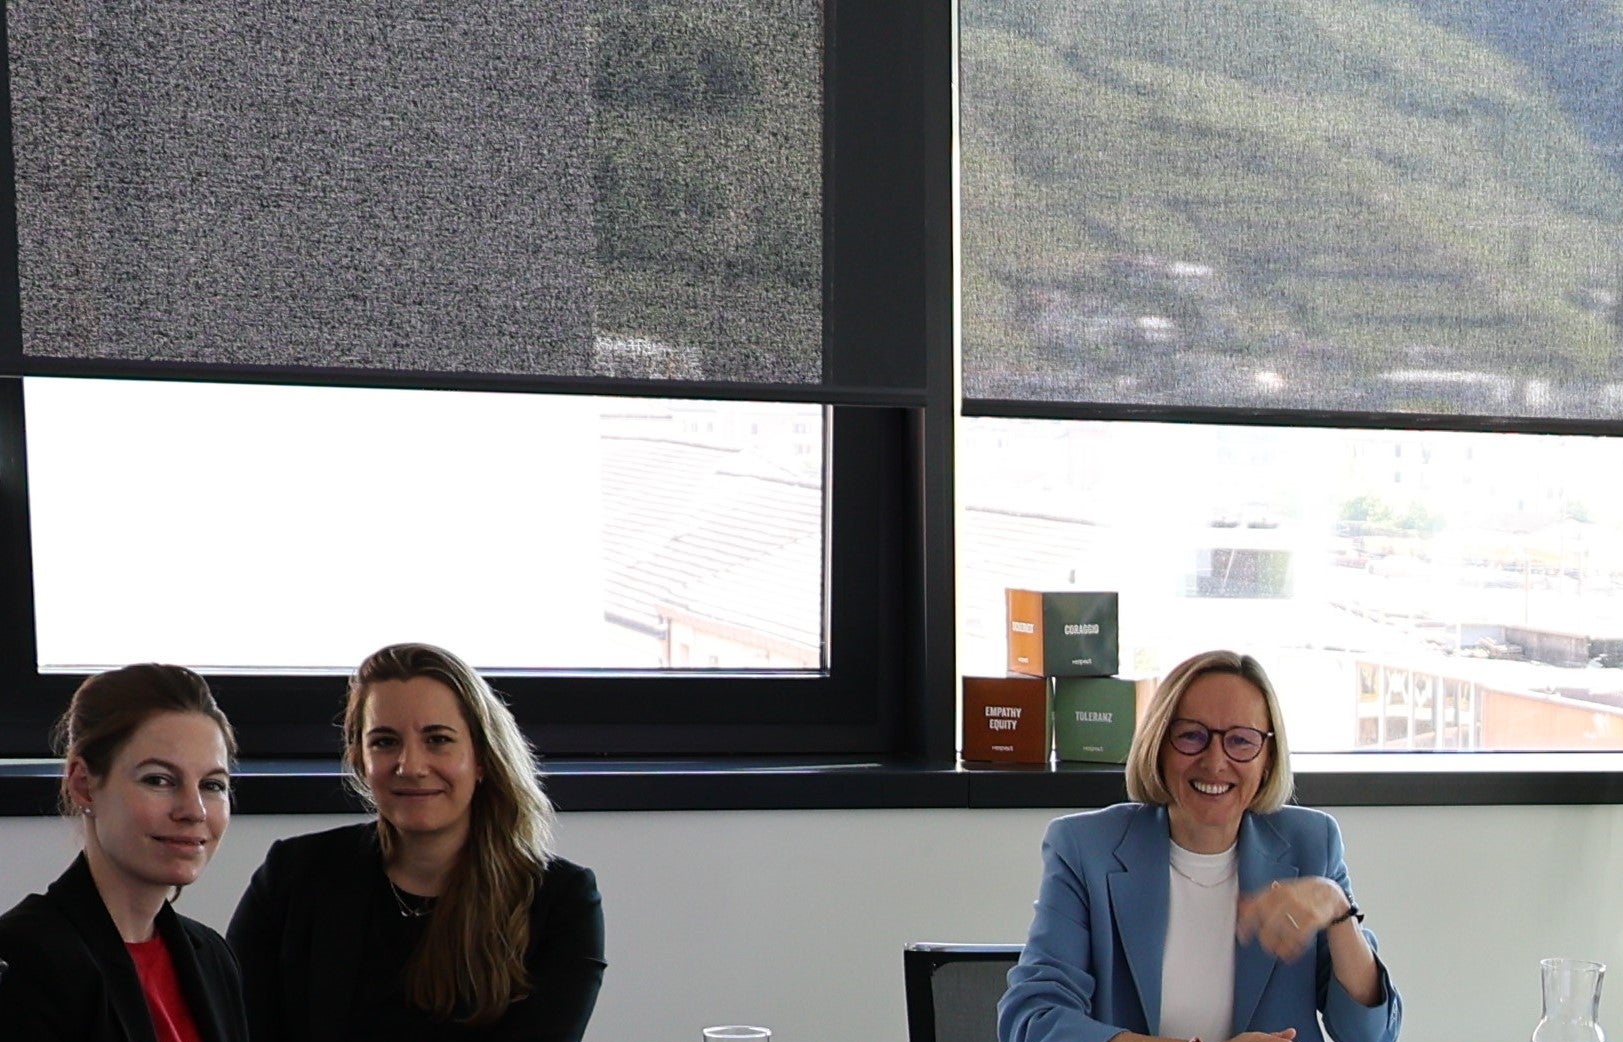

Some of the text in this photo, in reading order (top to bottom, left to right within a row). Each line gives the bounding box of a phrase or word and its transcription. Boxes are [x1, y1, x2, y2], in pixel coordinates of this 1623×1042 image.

[1064, 624, 1100, 635] CORAGGIO
[985, 706, 1022, 718] EMPATHY
[1075, 711, 1112, 723] TOLERANZ
[989, 718, 1017, 730] EQUITY
